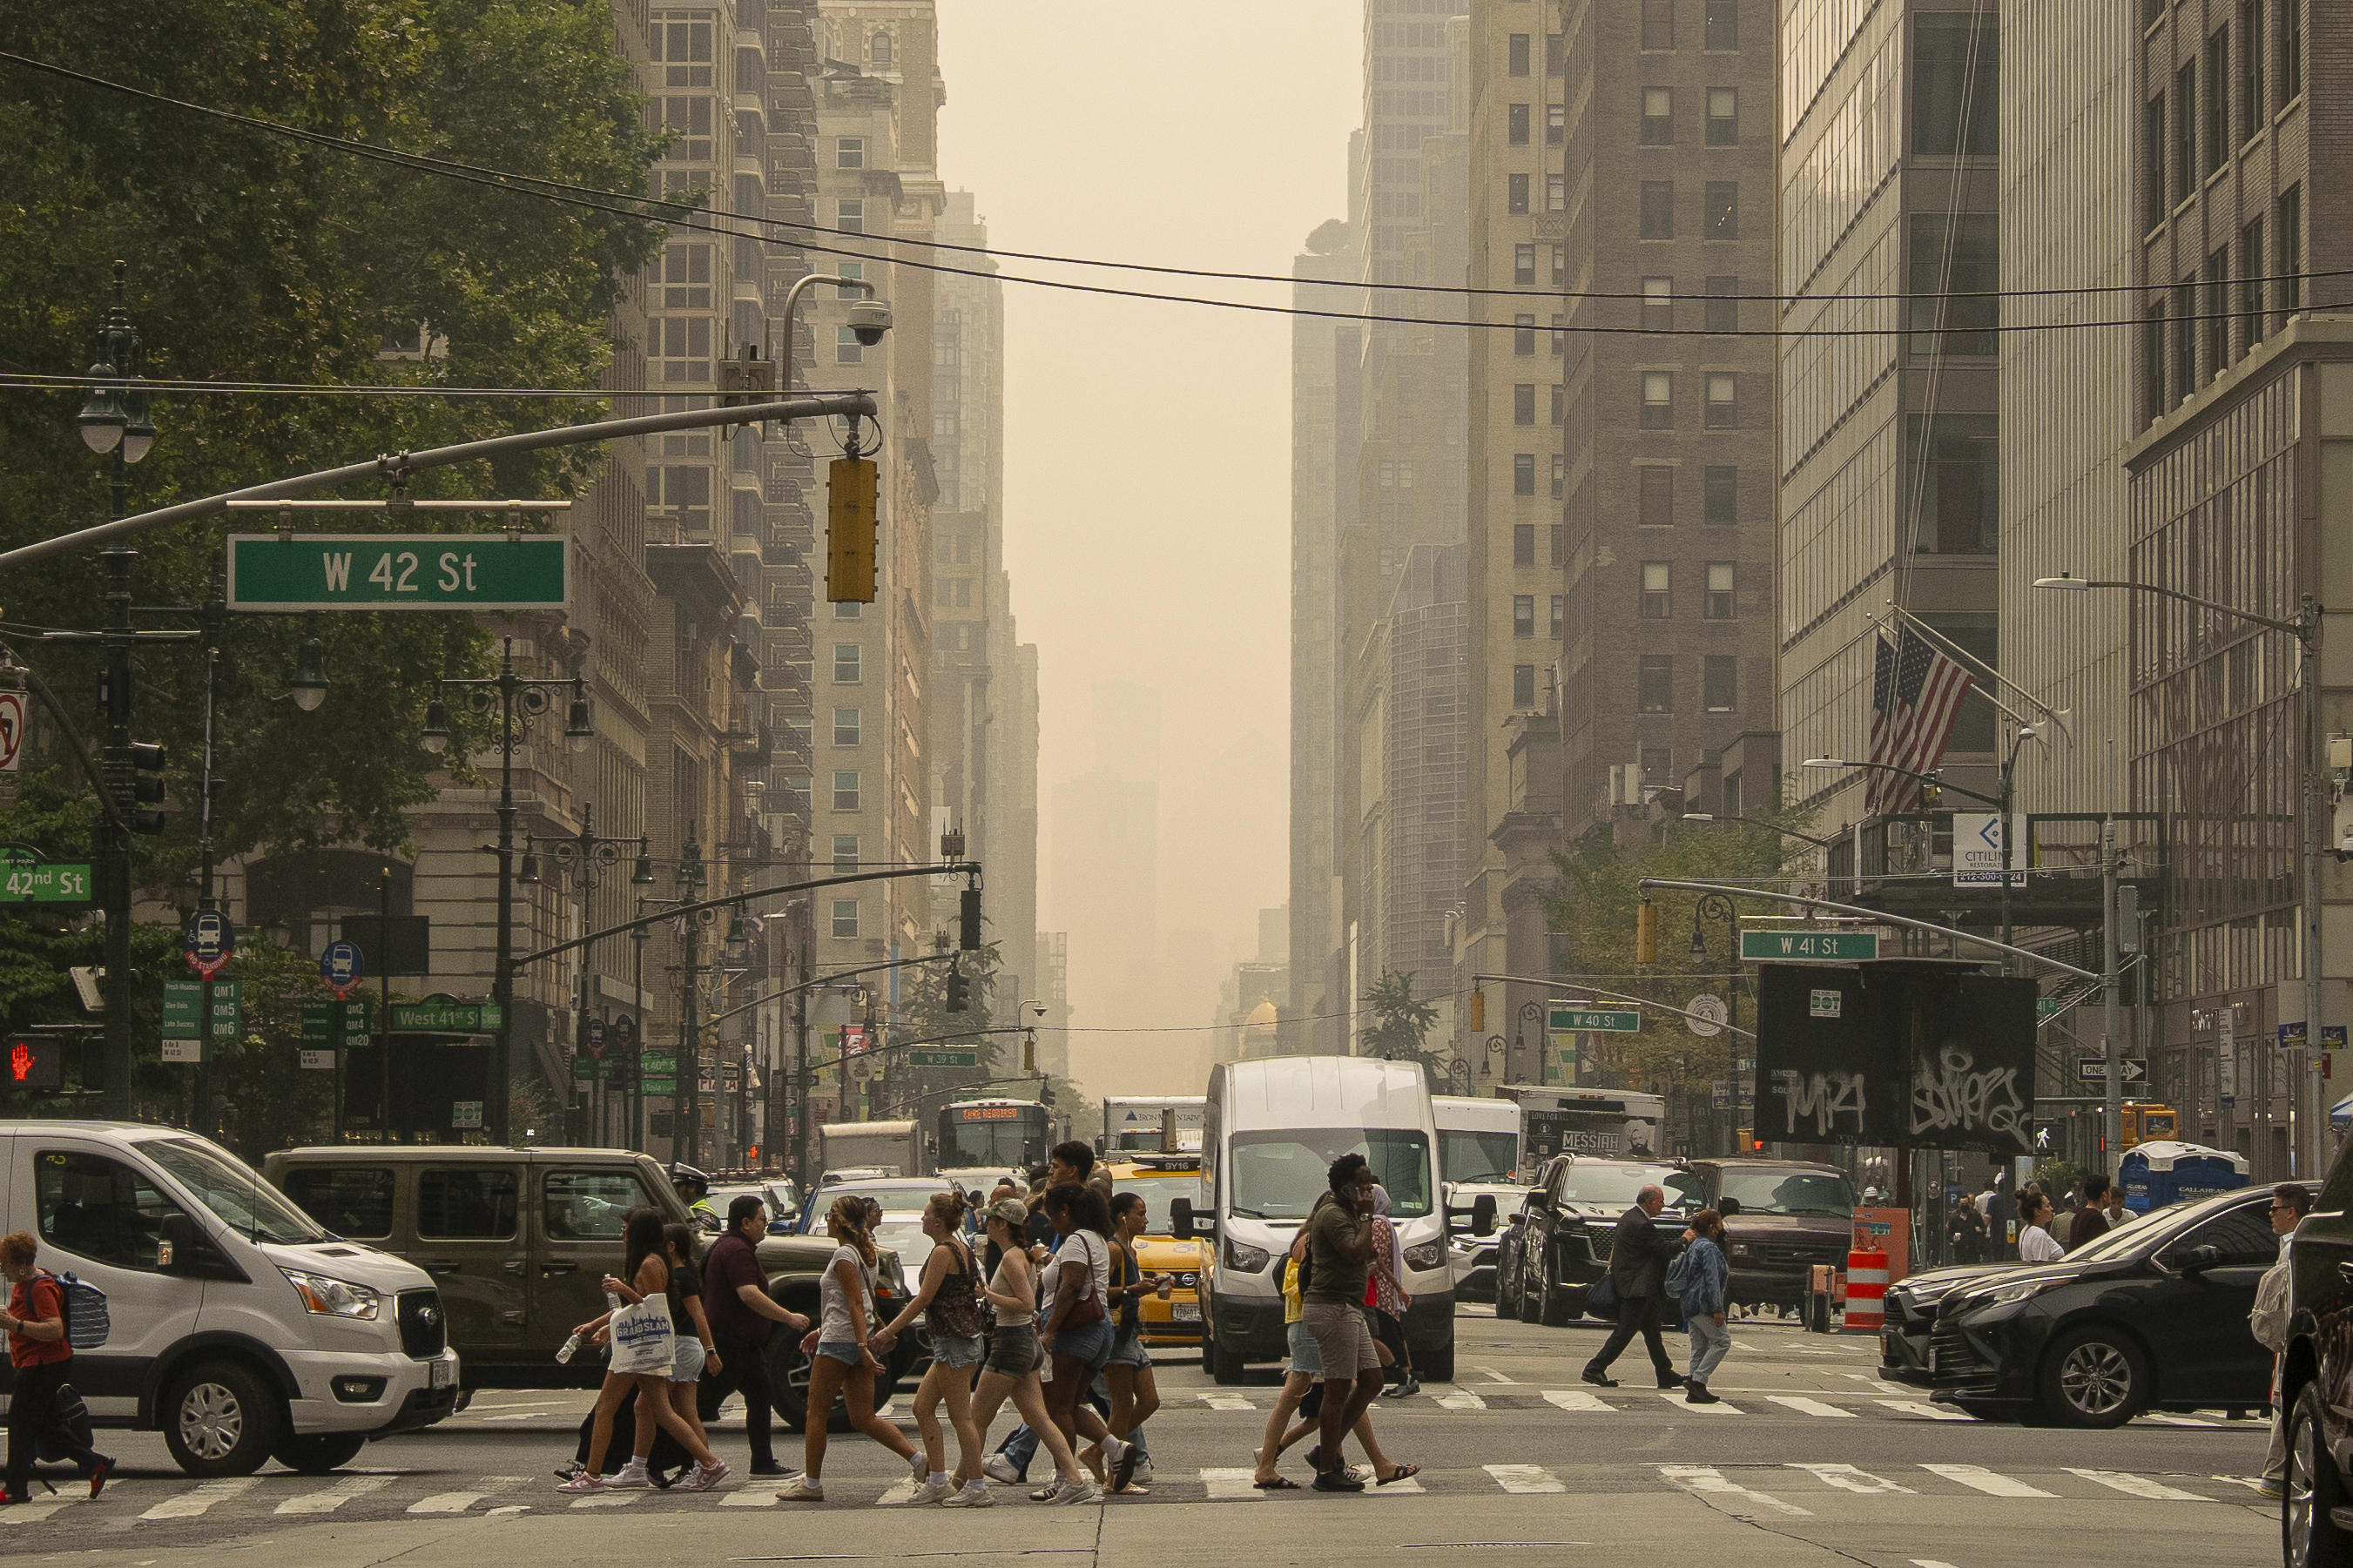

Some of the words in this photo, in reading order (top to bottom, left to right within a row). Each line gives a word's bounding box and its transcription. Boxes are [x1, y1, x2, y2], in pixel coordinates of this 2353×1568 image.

[323, 552, 352, 591] W
[368, 552, 419, 591] 42
[438, 552, 477, 591] St
[1965, 851, 2003, 861] CITILIN
[6, 870, 52, 895] 42nd
[59, 871, 84, 894] St
[1780, 937, 1793, 954] W
[1799, 938, 1815, 954] 41
[1822, 938, 1838, 955] St
[188, 952, 198, 965] NO
[198, 952, 228, 971] STANDING
[214, 984, 234, 998] QM1
[213, 1003, 235, 1017] QM5
[2036, 1000, 2046, 1012] 41
[400, 1011, 435, 1026] West
[439, 1011, 463, 1025] 41st
[1573, 1015, 1582, 1026] W
[1585, 1014, 1600, 1026] 40
[1603, 1015, 1615, 1027] St
[212, 1021, 235, 1035] QM6
[346, 1034, 369, 1046] QM20
[670, 1060, 678, 1070] S
[927, 1054, 934, 1064] W
[936, 1054, 946, 1064] 39
[949, 1054, 958, 1064] St
[2086, 1066, 2105, 1074] ONE
[700, 1079, 737, 1090] PIA
[1547, 1113, 1558, 1121] FOR
[1562, 1133, 1620, 1150] MESSIAH
[617, 1322, 644, 1337] GRAND
[644, 1321, 670, 1332] SLAM
